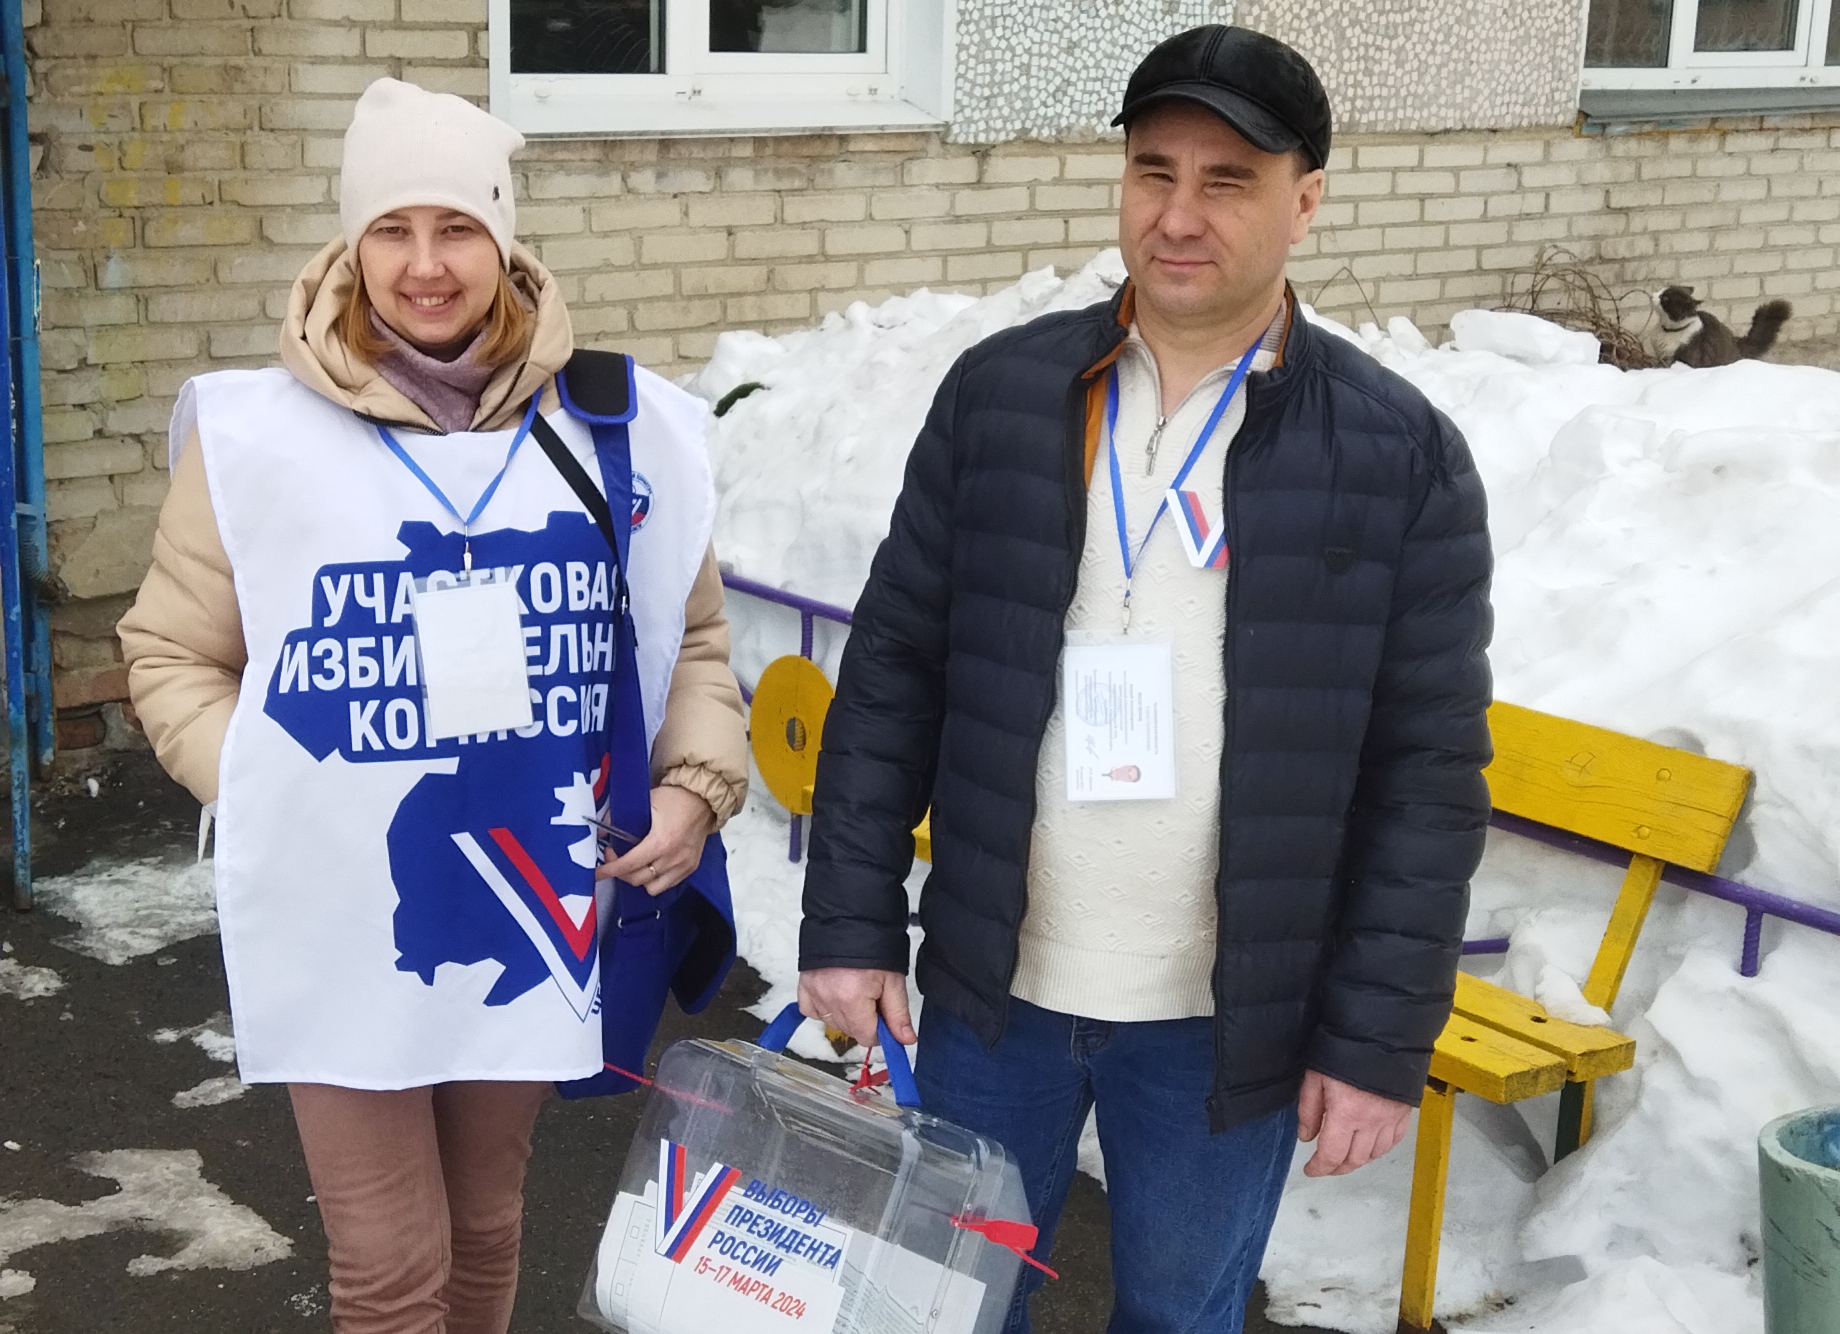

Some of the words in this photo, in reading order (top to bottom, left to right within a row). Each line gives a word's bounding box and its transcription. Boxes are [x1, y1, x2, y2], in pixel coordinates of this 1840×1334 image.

[349, 683, 609, 752] КОССИЯ
[743, 1178, 828, 1227] ВЫБОРЫ
[707, 1230, 784, 1277] РОССИИ
[724, 1204, 842, 1270] ПРЕЗИДЕНТА
[726, 1271, 774, 1305] МАРТА
[770, 1291, 807, 1320] 2024
